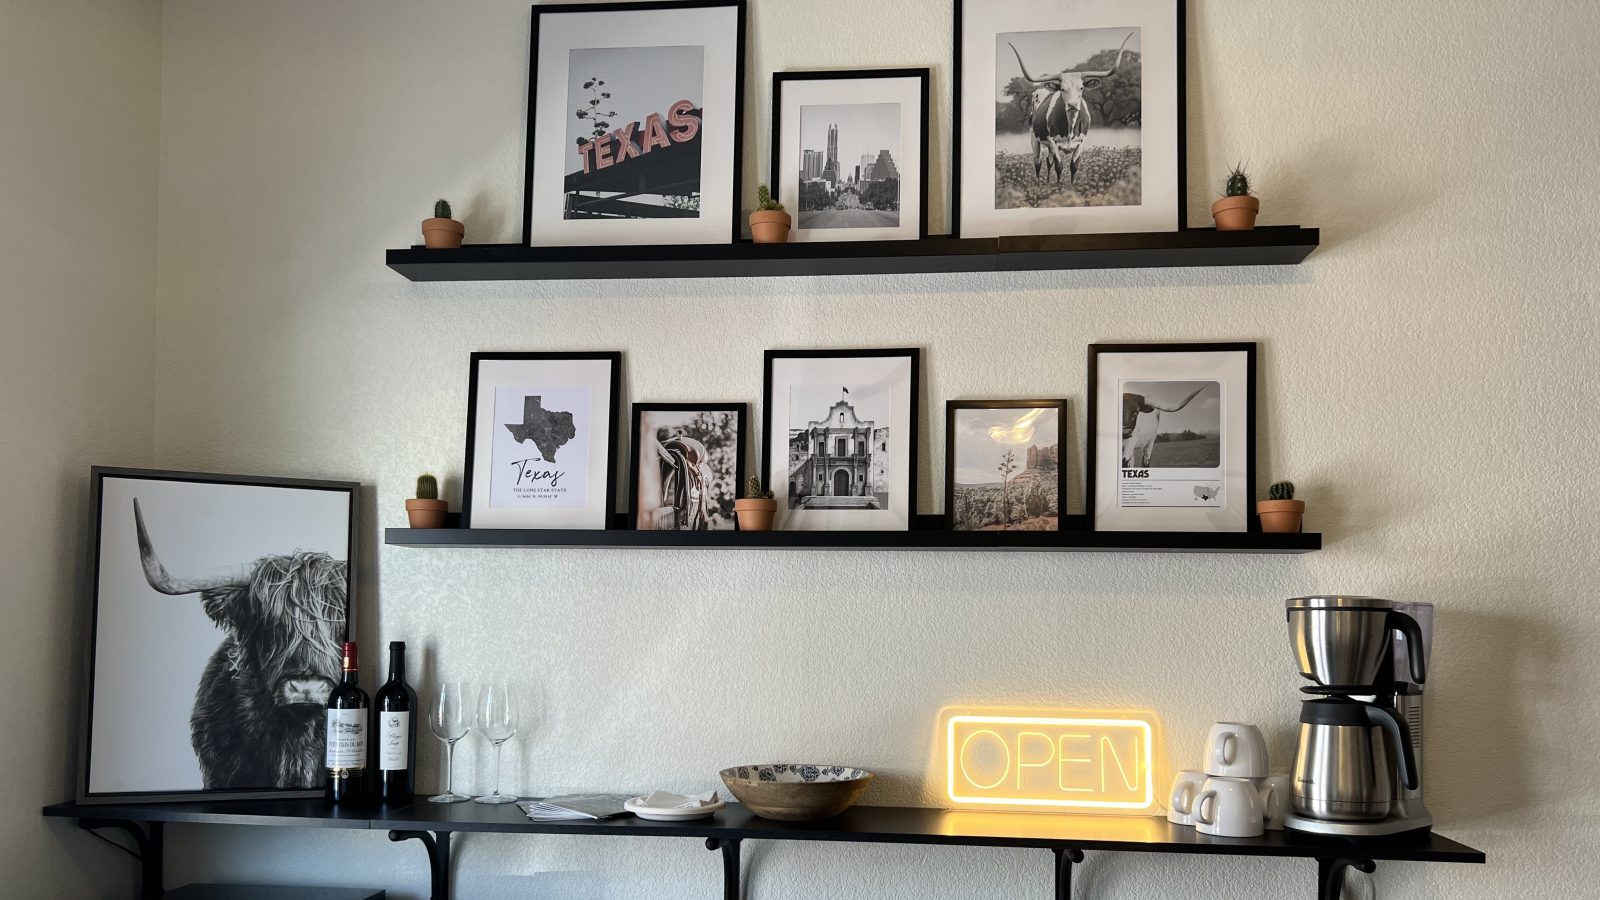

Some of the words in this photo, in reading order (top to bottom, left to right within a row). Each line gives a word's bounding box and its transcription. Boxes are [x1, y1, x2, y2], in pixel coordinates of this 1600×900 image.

[578, 99, 699, 175] TEXAS
[511, 457, 566, 487] Texas
[1121, 469, 1150, 479] TEXAS
[959, 729, 1139, 792] OPEN
